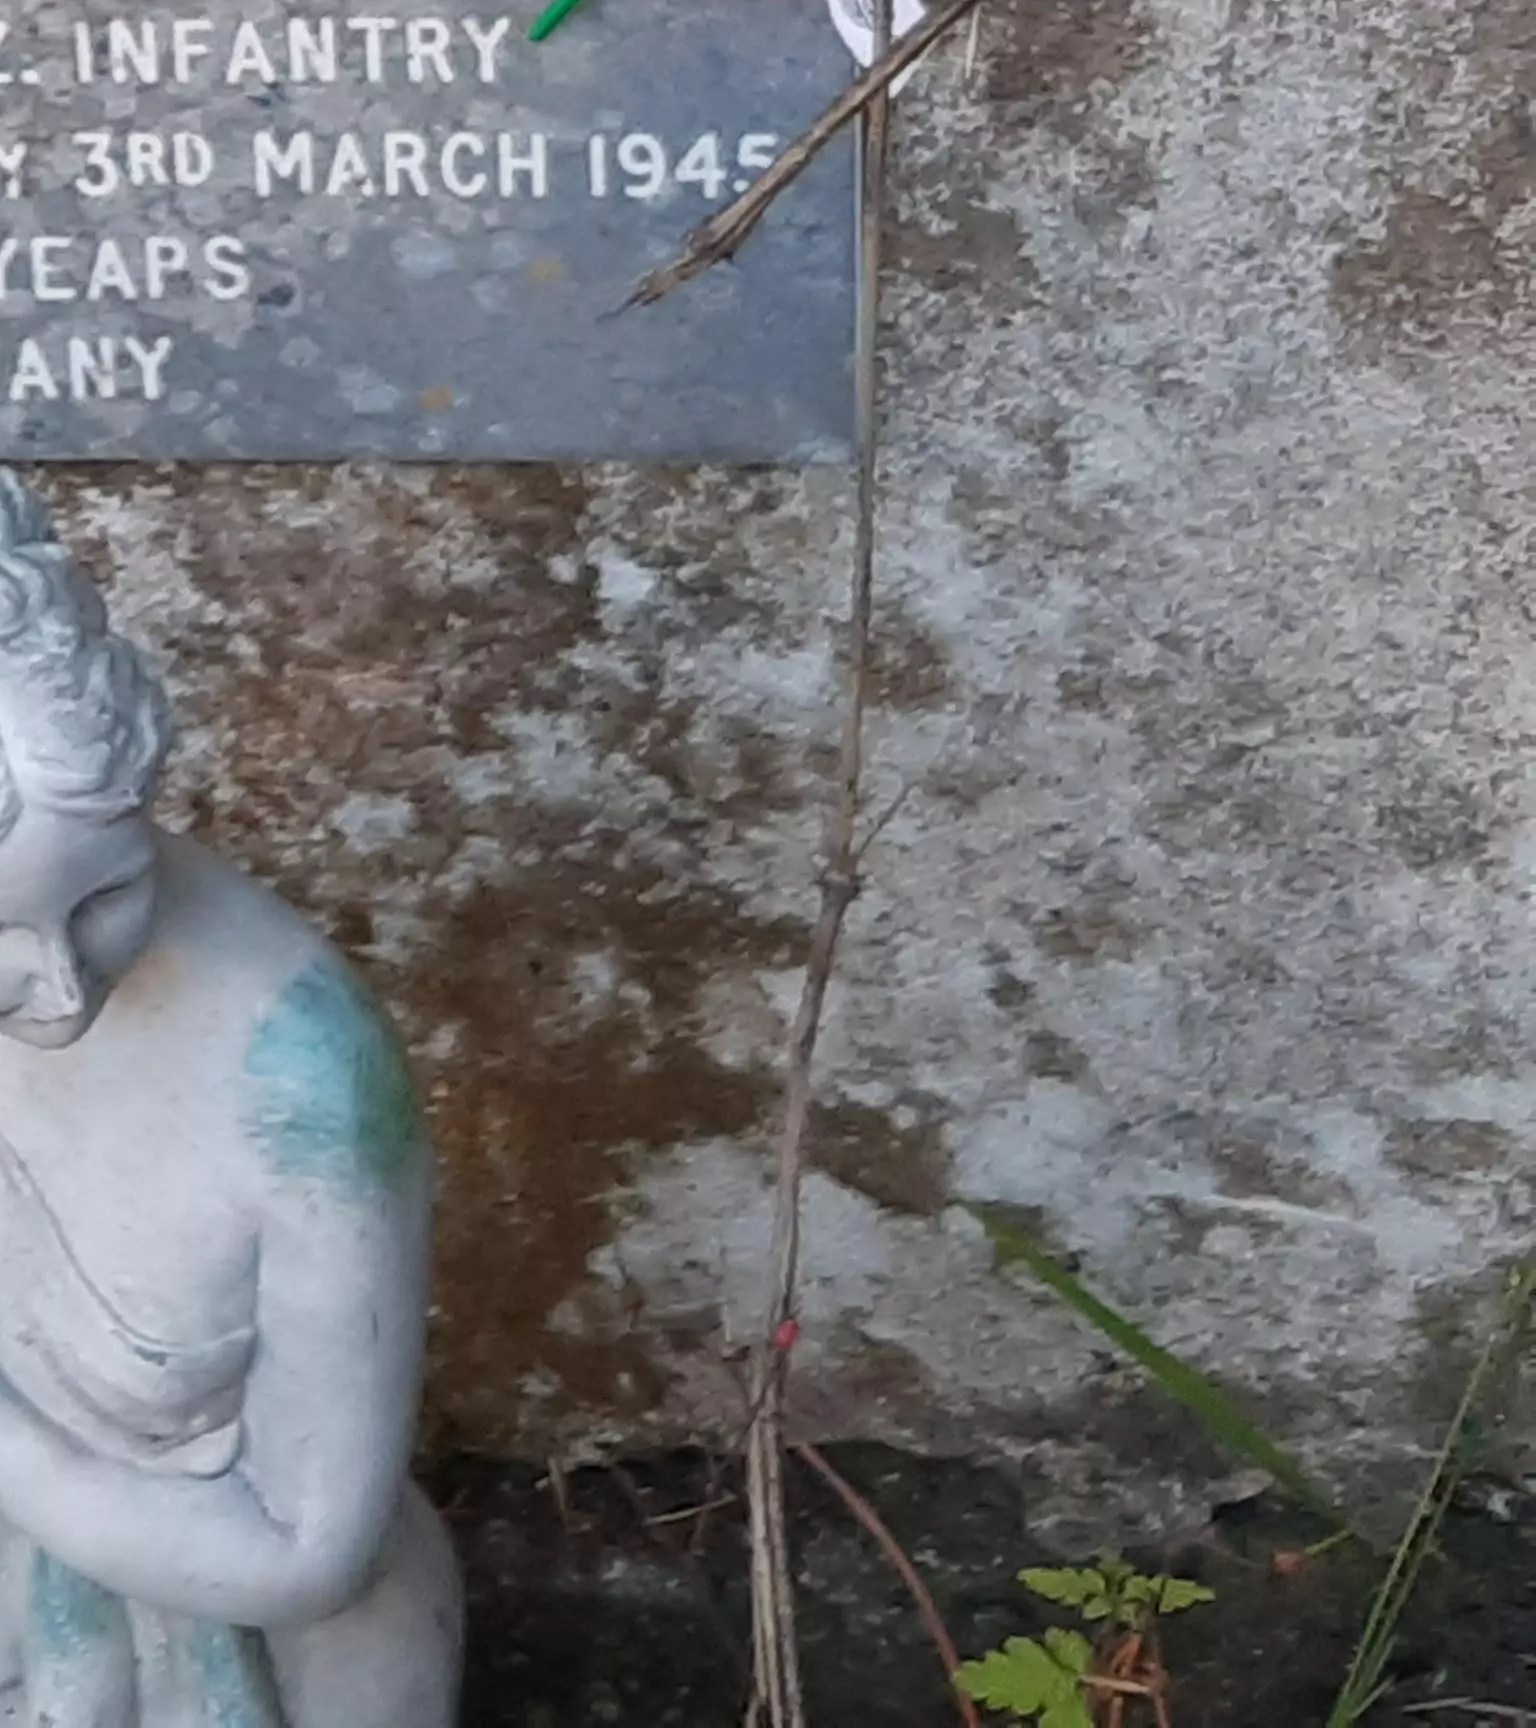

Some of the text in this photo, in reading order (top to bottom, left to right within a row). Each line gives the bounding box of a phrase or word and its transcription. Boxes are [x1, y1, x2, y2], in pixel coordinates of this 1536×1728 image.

[74, 15, 510, 84] INFANTRY
[72, 131, 214, 198] 3RD
[252, 130, 546, 198] MARCH
[589, 132, 778, 202] 1945
